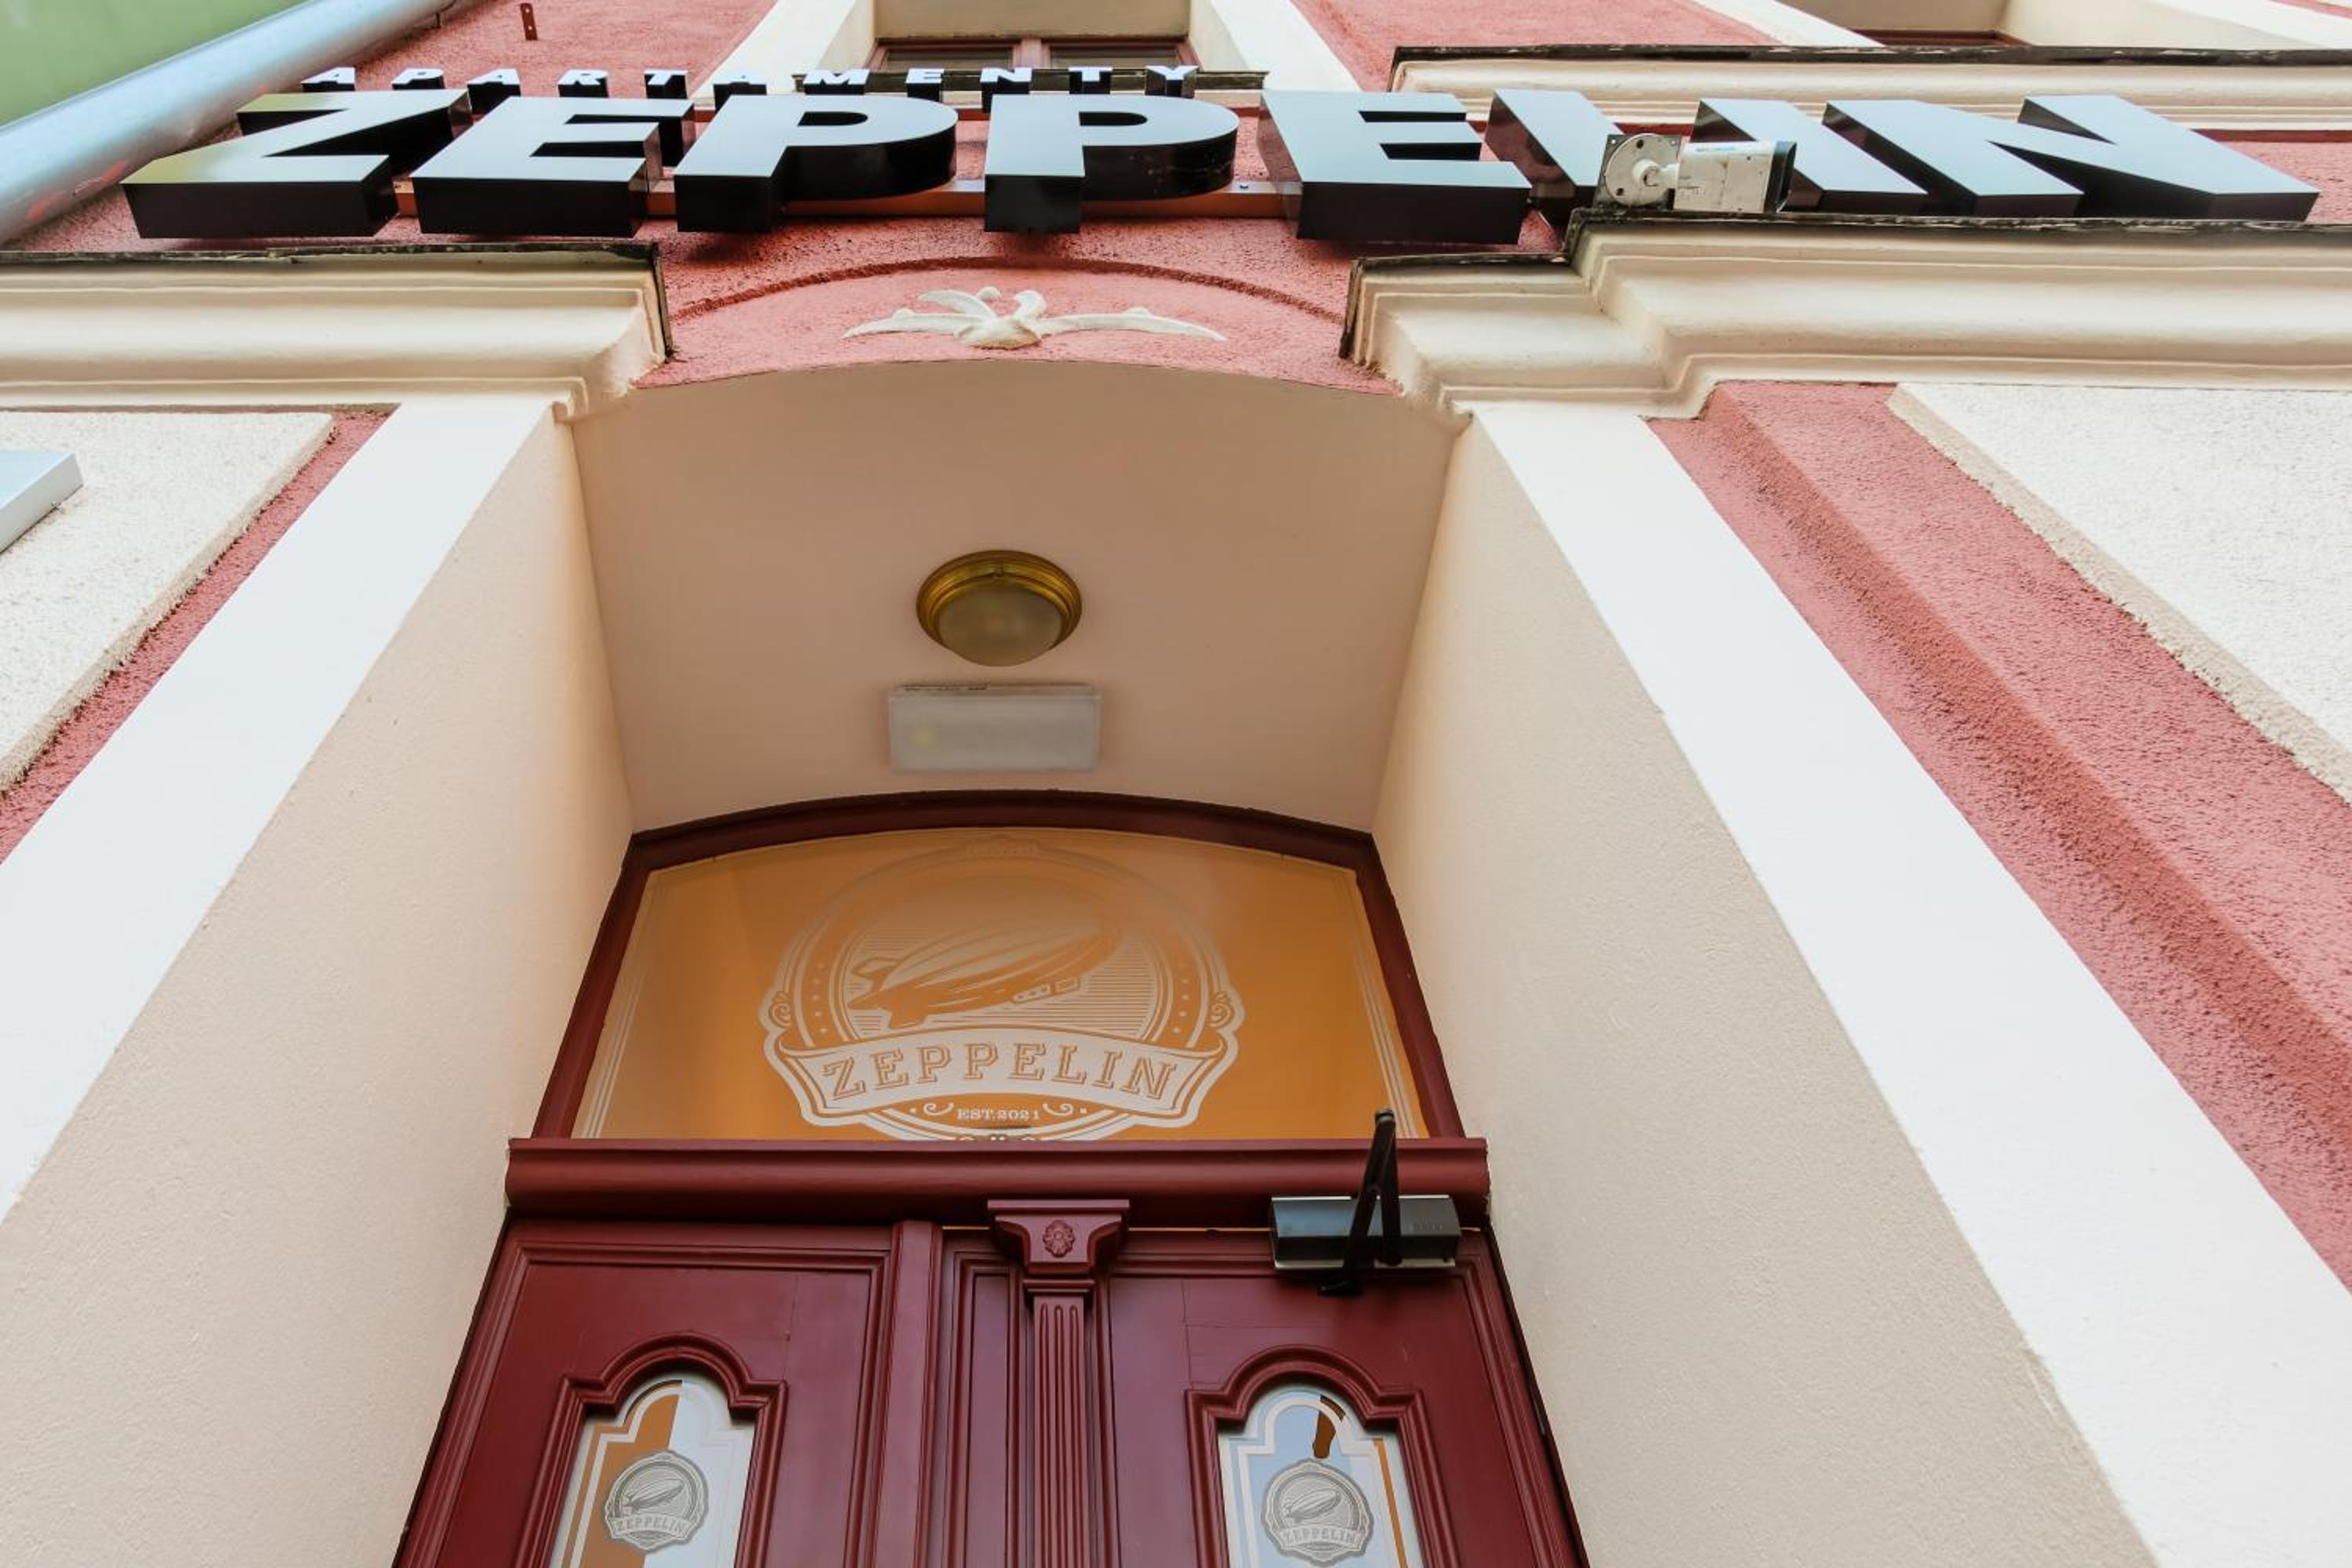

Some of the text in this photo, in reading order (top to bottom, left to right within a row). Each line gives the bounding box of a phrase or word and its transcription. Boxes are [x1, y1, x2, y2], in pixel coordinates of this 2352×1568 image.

[300, 65, 1198, 96] APARTAMENTY
[822, 1040, 1178, 1099] ZEPPELIN
[615, 1516, 685, 1533] ZEPPELIN
